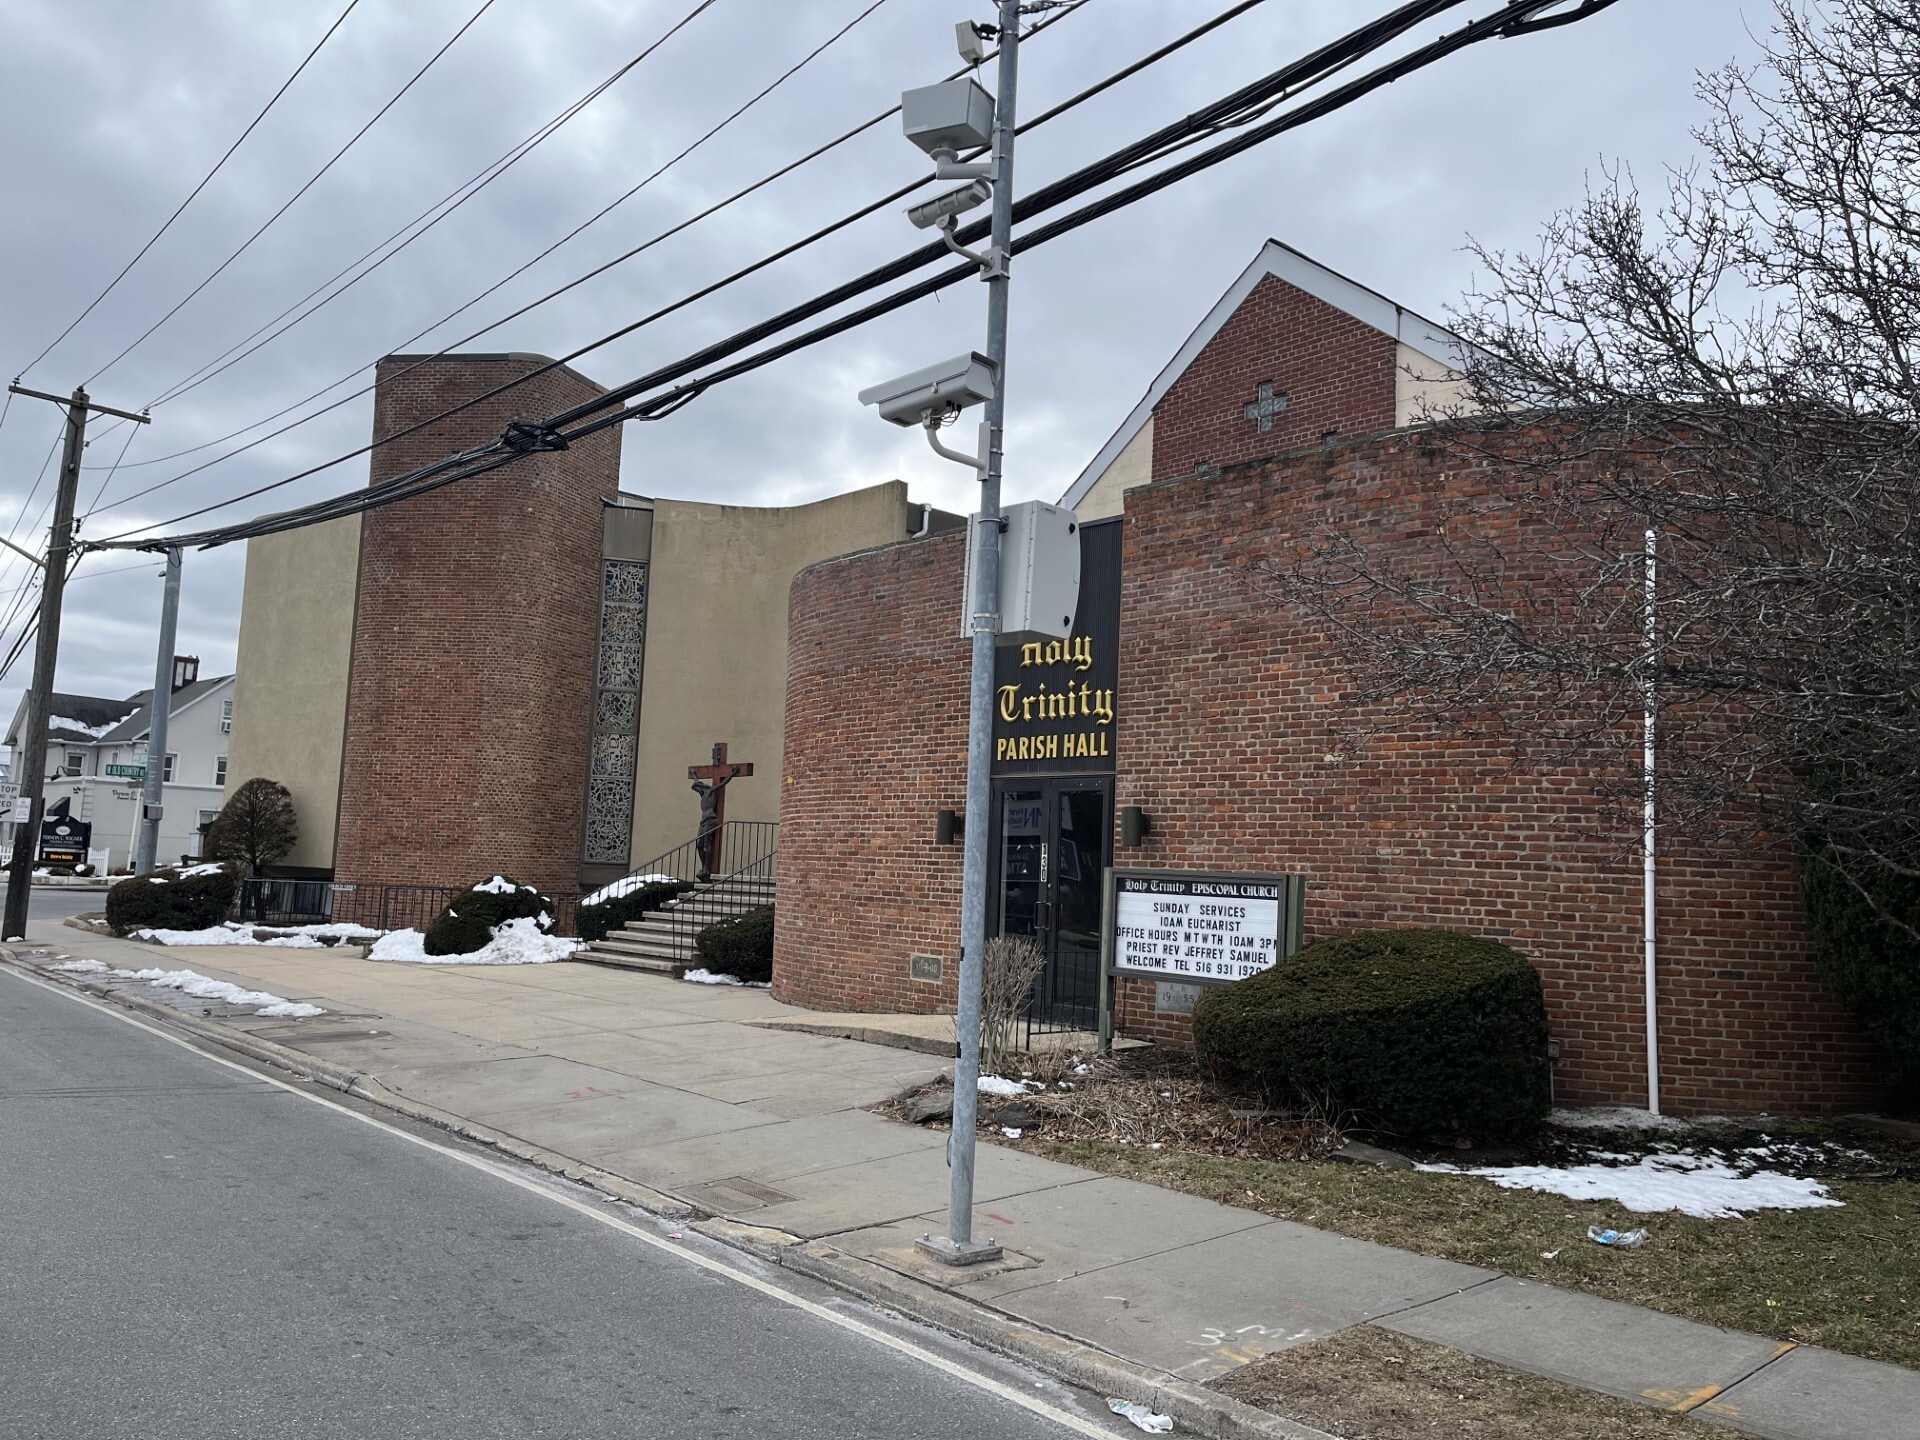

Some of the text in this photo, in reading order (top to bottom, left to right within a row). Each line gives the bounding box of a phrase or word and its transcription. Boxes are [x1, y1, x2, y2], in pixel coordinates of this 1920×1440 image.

[997, 680, 1114, 726] Trinity
[997, 732, 1108, 760] PARISH HALL
[1, 785, 17, 793] TOP
[1125, 879, 1278, 897] Holy Trinity EPISCOPAL CHURCH
[1153, 902, 1246, 918] SUNDAY SERVICES
[1160, 916, 1241, 932] 10AM EUCHARIST
[1116, 926, 1144, 938] OFFICE
[1148, 930, 1178, 941] HOURS
[1230, 936, 1254, 948] 10AM
[1126, 942, 1269, 964] PRIEST REV JEFFREY SAMUEL
[1126, 954, 1167, 968] WELCOME
[1174, 960, 1190, 971] TEL
[1196, 962, 1212, 973] 516
[1217, 964, 1232, 975] 931
[1162, 992, 1171, 1002] 19
